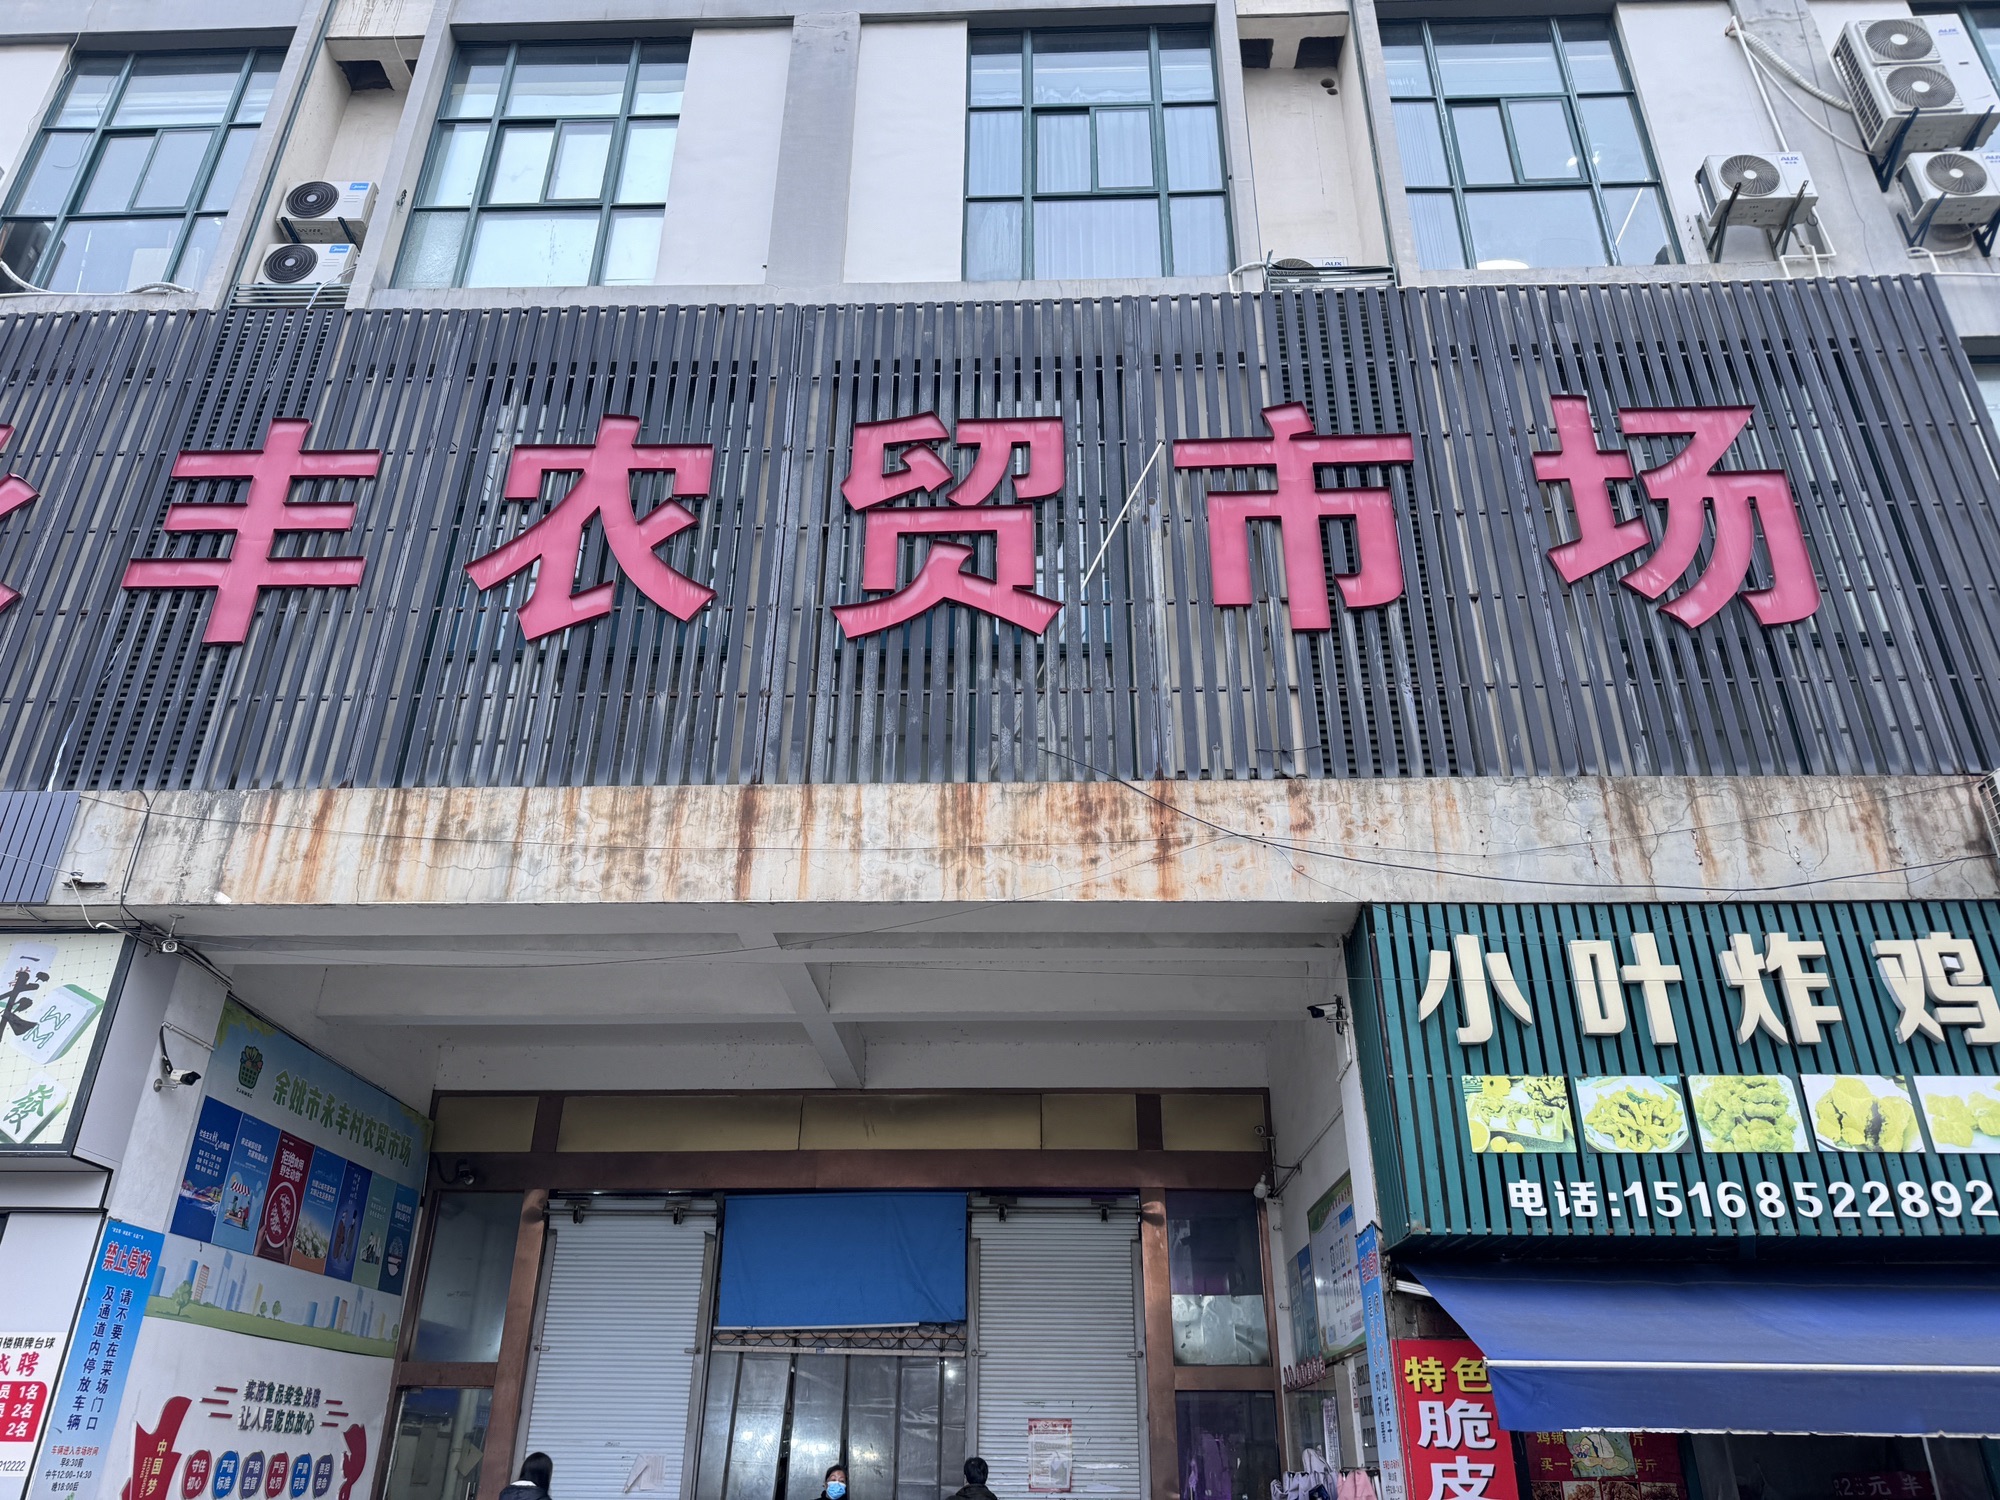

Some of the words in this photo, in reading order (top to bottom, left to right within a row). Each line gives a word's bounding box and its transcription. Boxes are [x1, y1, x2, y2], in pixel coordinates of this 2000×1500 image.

[0, 398, 1817, 645] 丰农贸市场
[1418, 931, 2000, 1046] 小叶炸鸡
[272, 1069, 414, 1167] 余姚市永丰村农贸市场
[1508, 1180, 1999, 1218] 电话:15168522892
[102, 1241, 153, 1279] 禁止停放
[0, 1337, 56, 1349] 楼棋牌台球
[67, 1285, 115, 1431] 及通道内停放车辆
[86, 1288, 134, 1431] 请不要在菜场门口
[1404, 1356, 1492, 1392] 特色
[19, 1384, 39, 1400] 1名
[243, 1380, 322, 1408] 实施食品安全战略
[11, 1404, 35, 1419] 2名
[237, 1406, 315, 1435] 让人民吃的放心
[5, 1422, 29, 1437] 2名
[51, 1445, 99, 1456] 车辆进入市场时间
[59, 1458, 85, 1467] 早8:30前
[1417, 1398, 1503, 1500] 脆皮
[45, 1470, 92, 1480] 中午12:00-14:30
[146, 1439, 168, 1496] 中国梦
[51, 1481, 80, 1492] 晚18:00后
[186, 1476, 202, 1490] 初心
